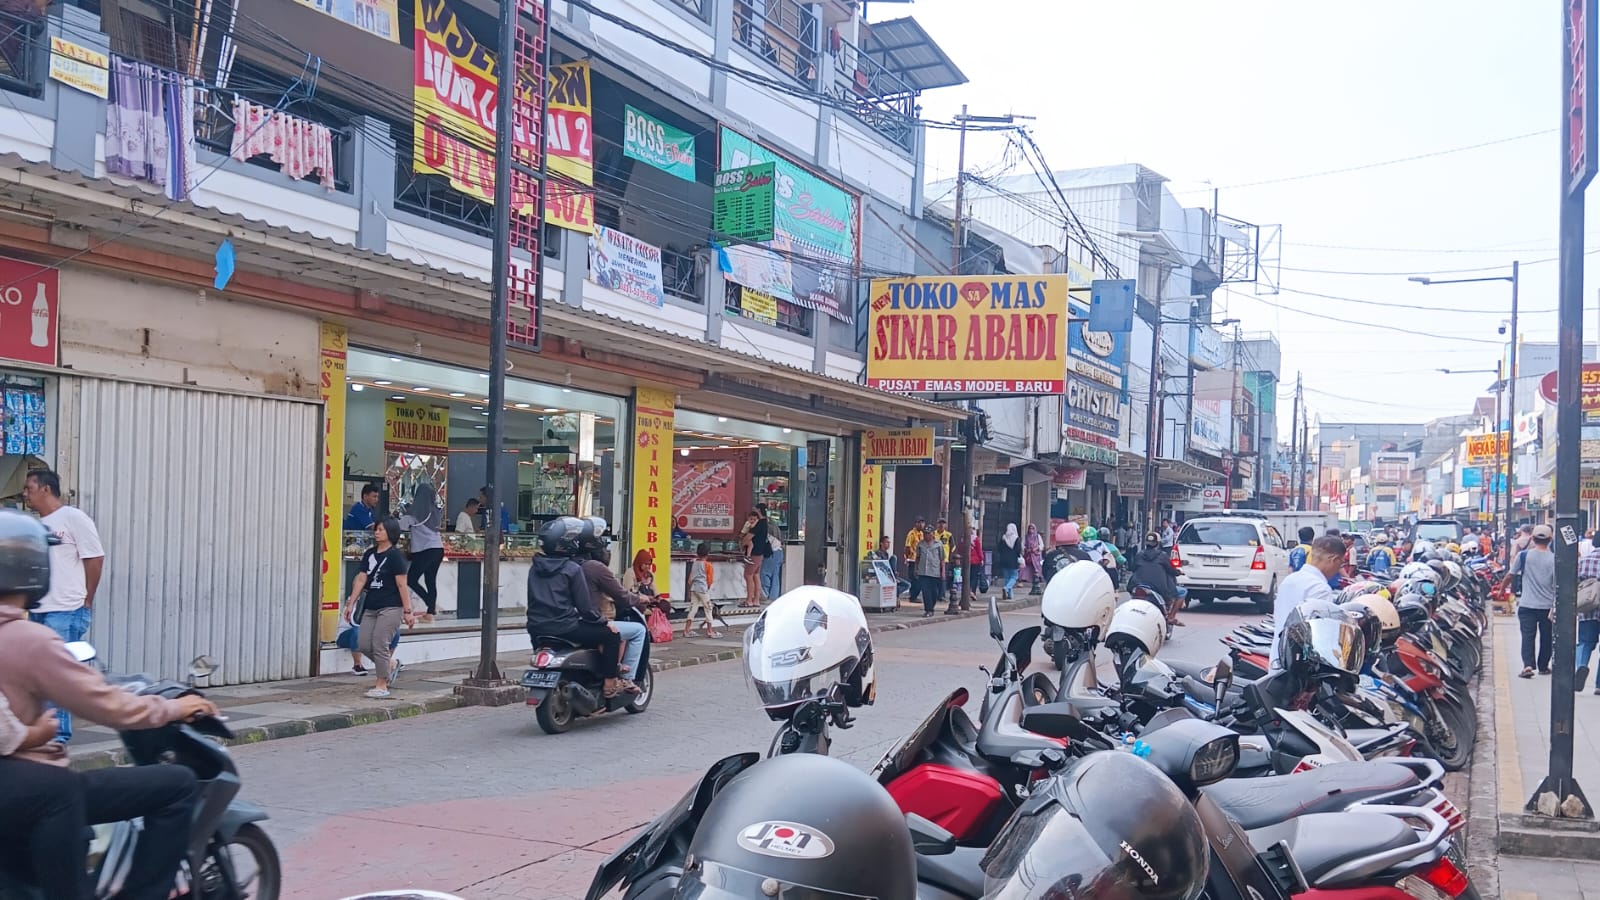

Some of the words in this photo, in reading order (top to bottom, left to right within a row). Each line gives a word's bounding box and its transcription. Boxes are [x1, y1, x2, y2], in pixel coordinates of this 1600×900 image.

[626, 109, 665, 155] BOSS
[715, 170, 743, 187] BOSS
[871, 292, 891, 312] NEW
[888, 282, 958, 310] TOKO
[990, 281, 1047, 310] MAS
[875, 314, 958, 361] SINAR
[964, 313, 1058, 361] ABADI
[879, 379, 919, 391] PUSAT
[925, 380, 962, 391] EMAS
[965, 380, 1010, 392] MODEL
[1015, 380, 1053, 392] BARU
[1067, 380, 1120, 420] CRYSTAL
[396, 408, 415, 417] TOKO
[392, 421, 417, 440] SINAR
[421, 424, 446, 443] ABADI
[871, 438, 896, 456] SINAR
[899, 438, 928, 456] ABADI
[1468, 441, 1490, 457] ANEKA
[770, 843, 803, 855] HELMET
[1120, 840, 1159, 885] HONDA
